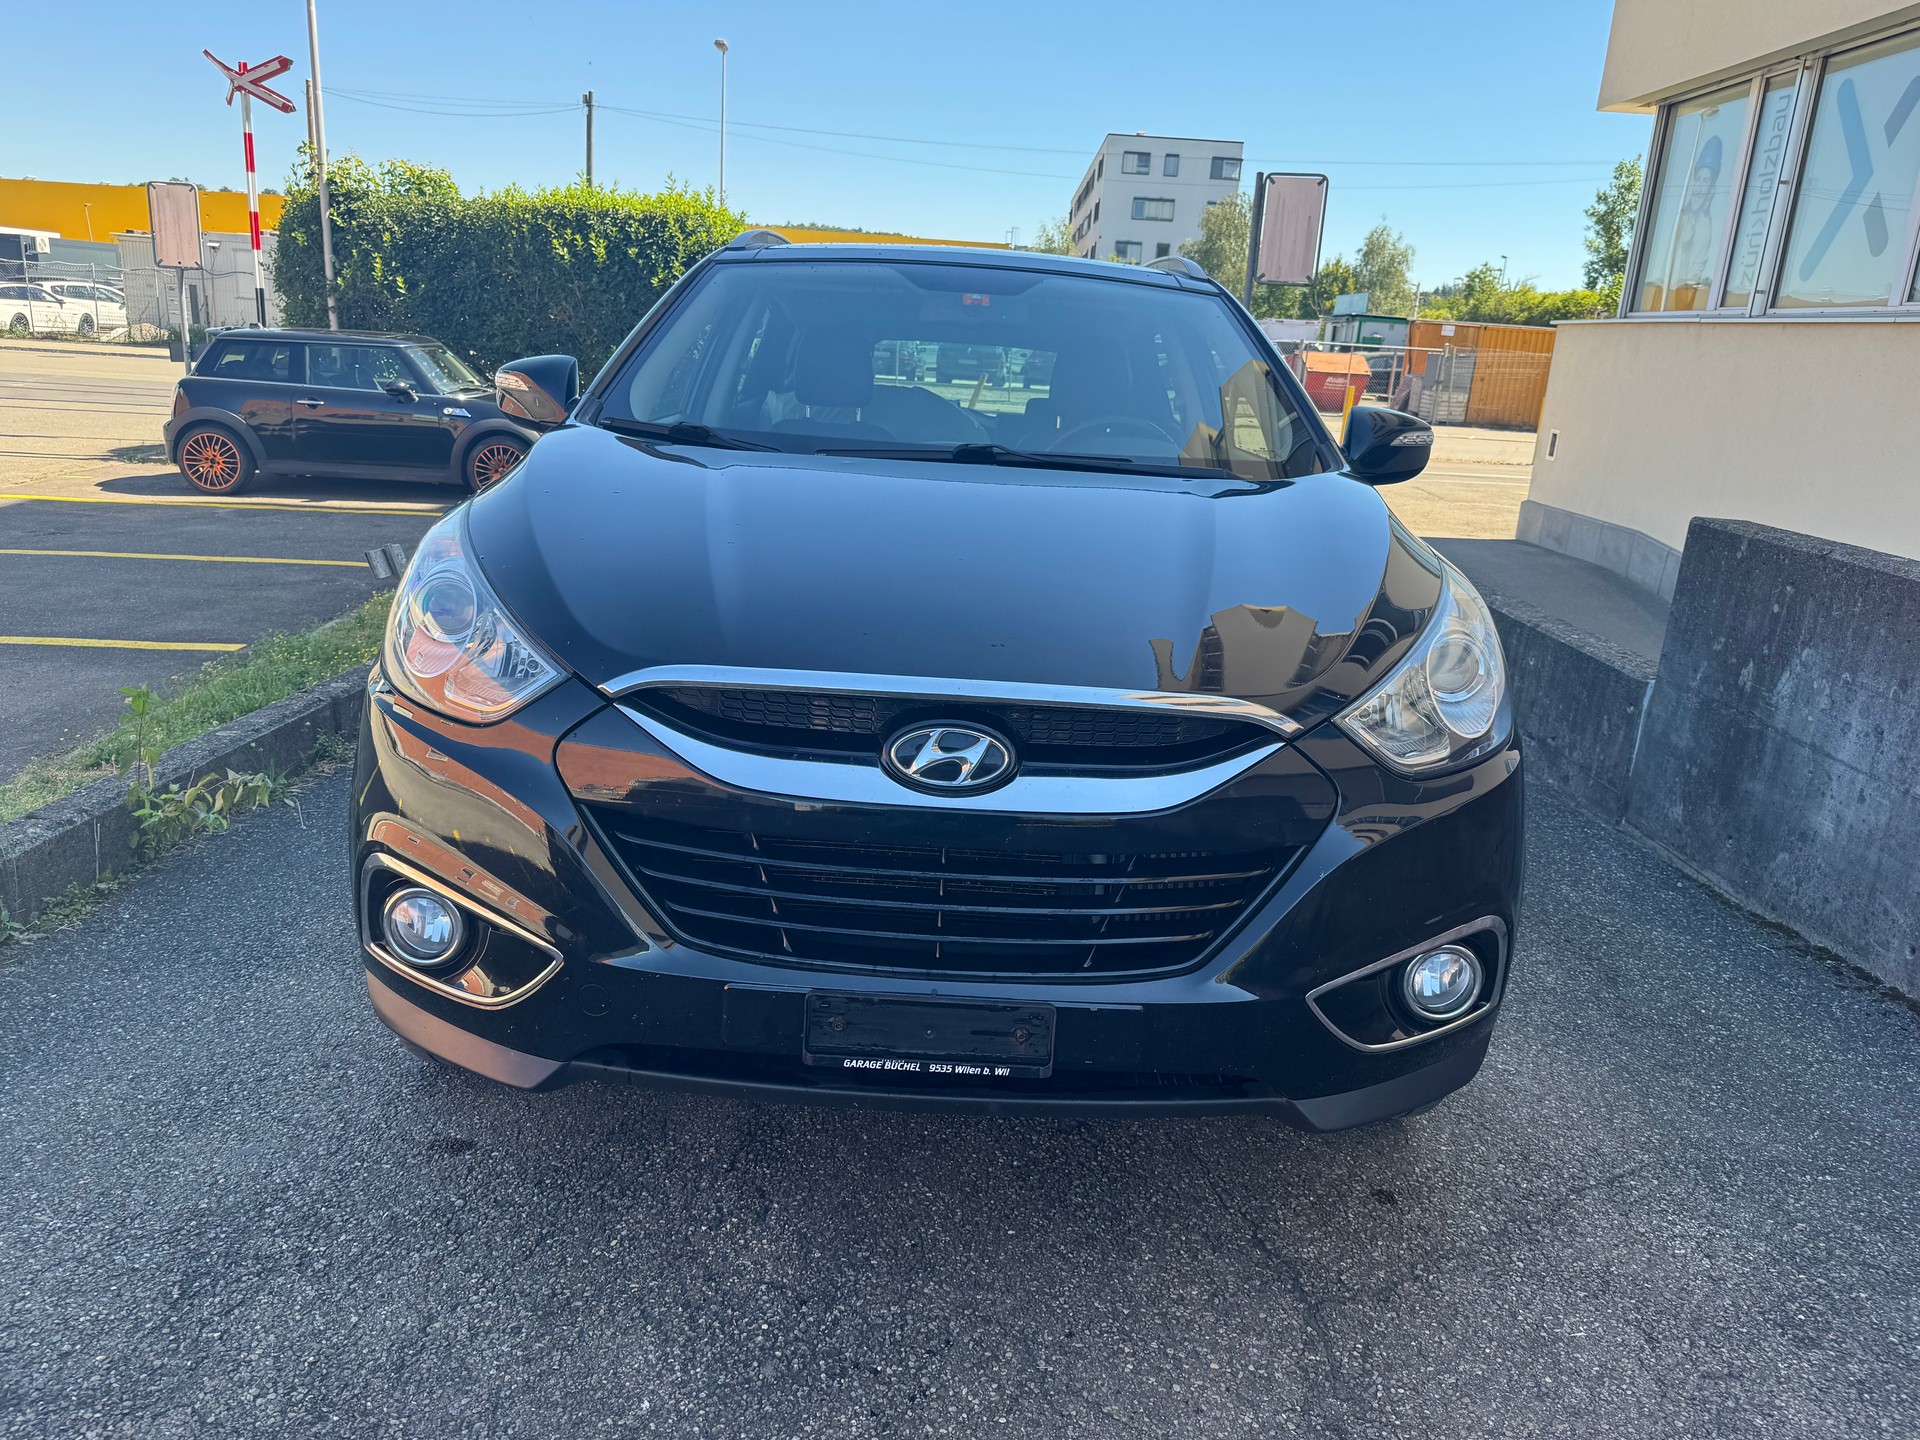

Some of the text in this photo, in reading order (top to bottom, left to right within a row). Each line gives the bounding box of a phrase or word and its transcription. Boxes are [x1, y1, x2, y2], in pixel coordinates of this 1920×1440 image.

[843, 1059, 882, 1069] GARAGE
[929, 1064, 953, 1073] 9535
[955, 1065, 980, 1075] Wilen
[983, 1067, 992, 1076] b.
